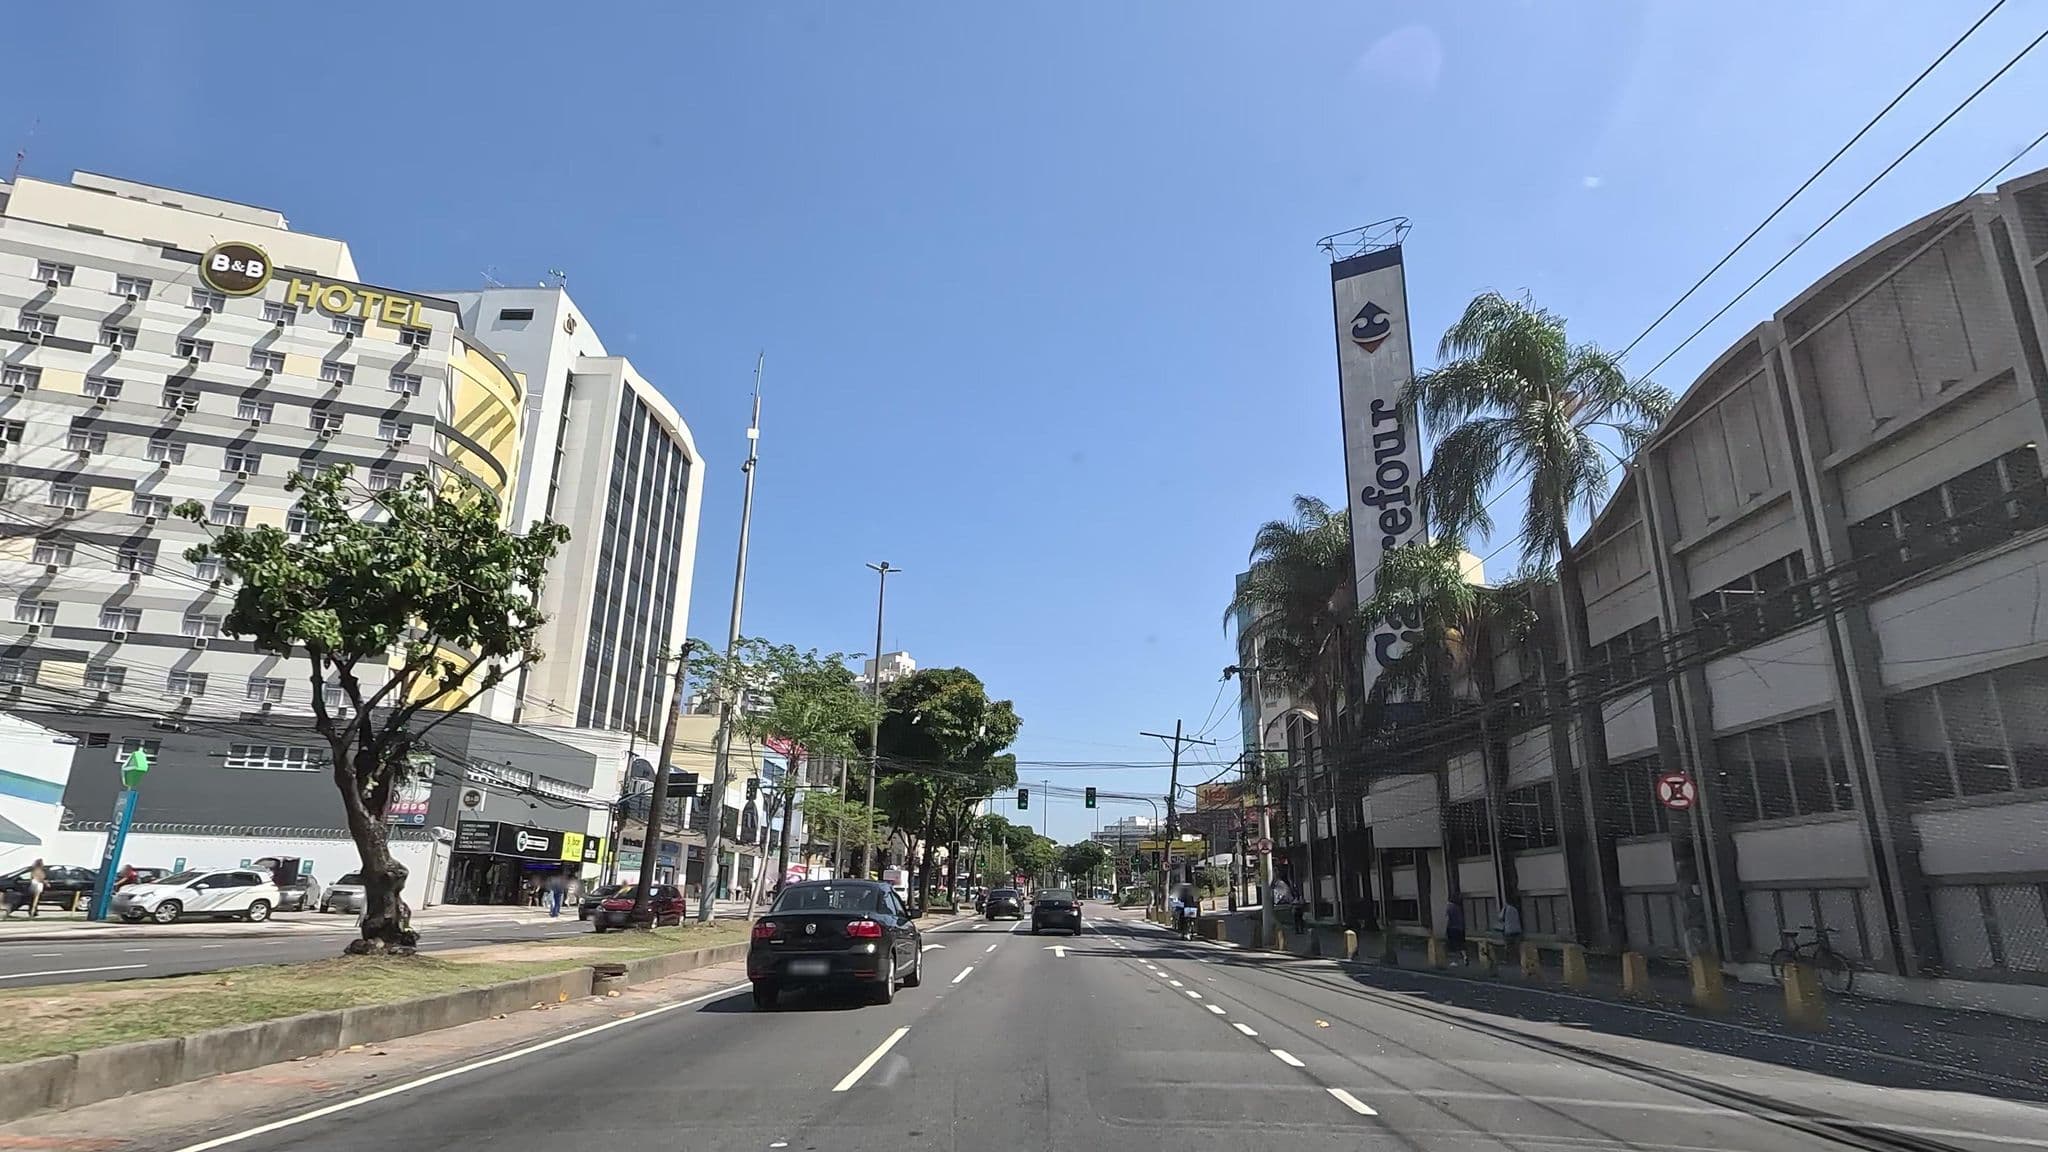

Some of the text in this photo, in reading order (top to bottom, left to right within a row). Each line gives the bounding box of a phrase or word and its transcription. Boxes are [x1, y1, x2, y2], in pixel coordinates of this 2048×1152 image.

[211, 253, 264, 278] B&B
[287, 278, 432, 329] HOTEL
[1362, 399, 1425, 670] Caefour
